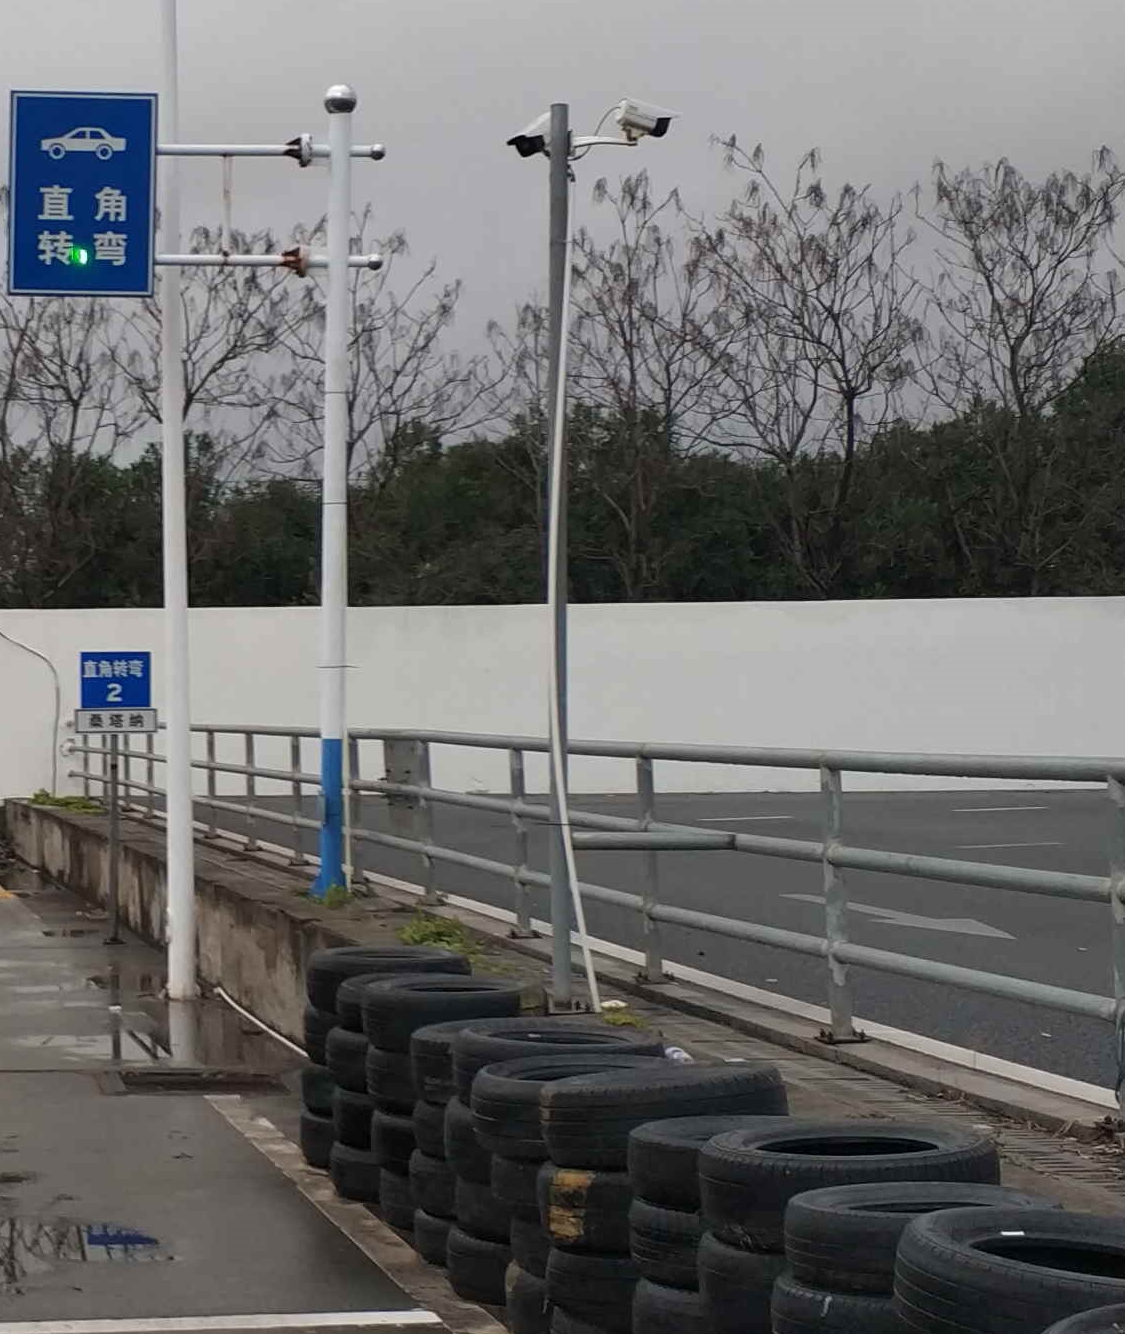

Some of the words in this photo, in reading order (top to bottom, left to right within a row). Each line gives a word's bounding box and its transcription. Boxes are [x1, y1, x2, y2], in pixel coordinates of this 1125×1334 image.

[38, 185, 127, 221] 直角
[38, 231, 127, 266] 转弯
[82, 660, 144, 678] 直角转弯
[106, 683, 123, 702] 2
